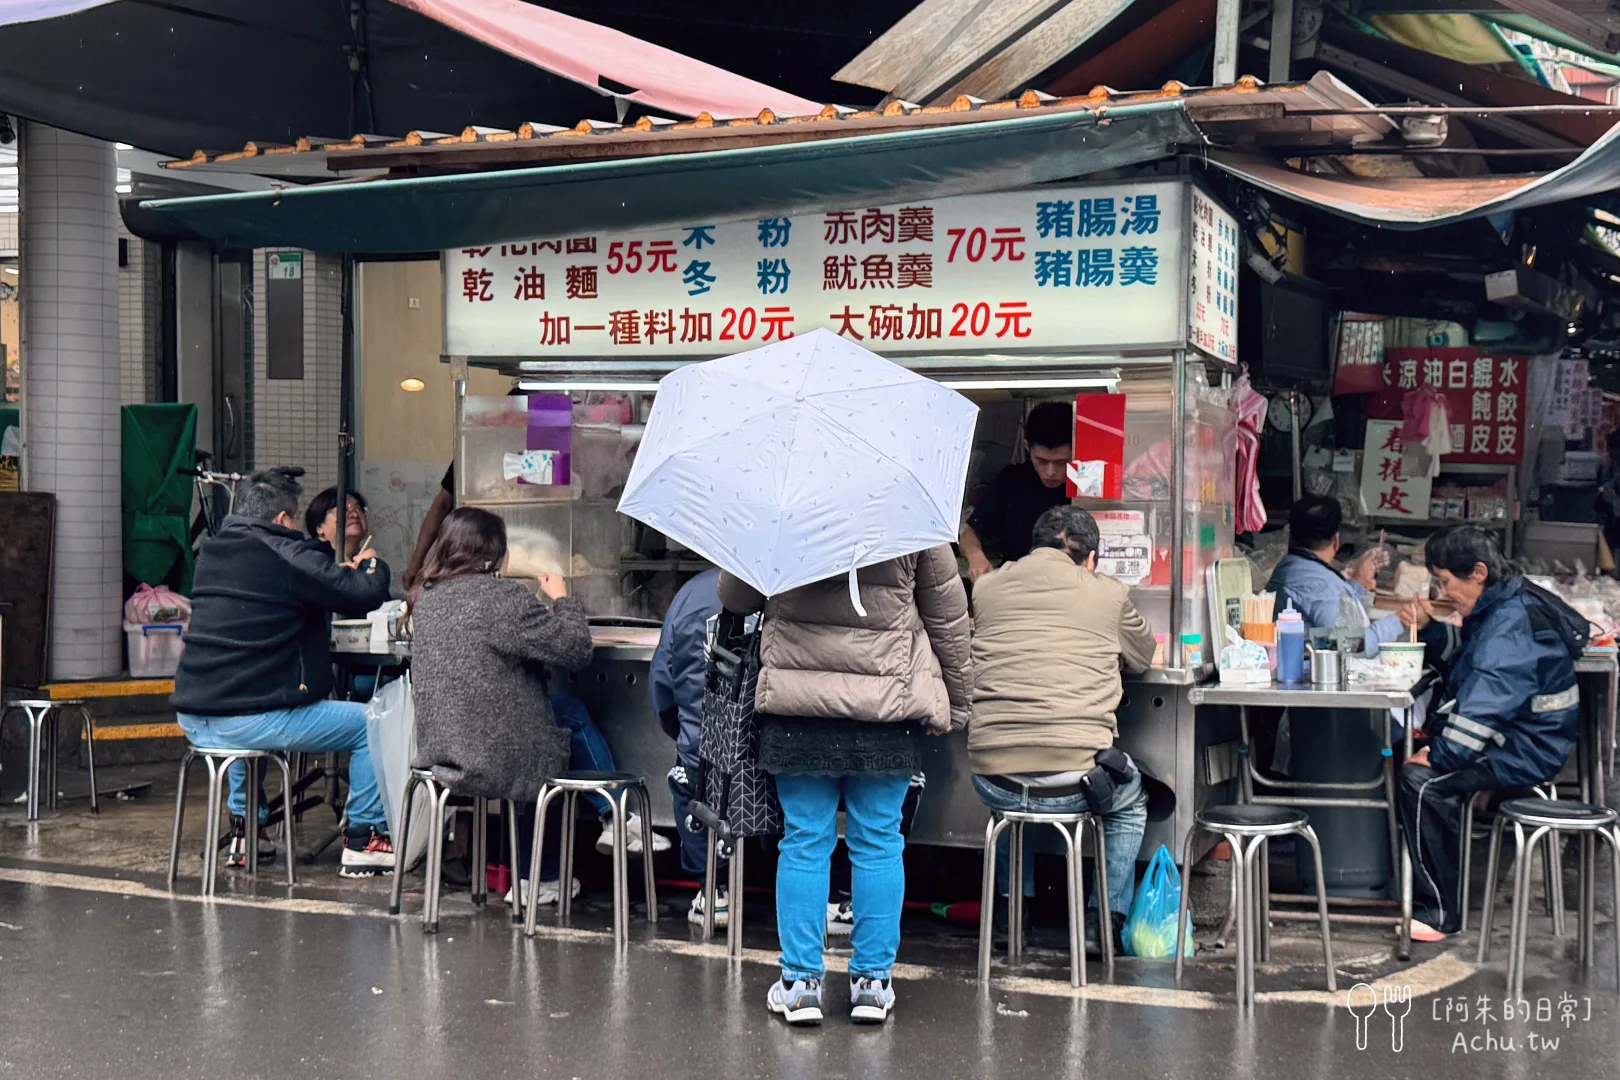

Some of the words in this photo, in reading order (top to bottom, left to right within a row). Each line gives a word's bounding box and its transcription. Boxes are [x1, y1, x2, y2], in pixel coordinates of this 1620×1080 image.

[824, 206, 934, 245] 赤肉羹
[1036, 194, 1161, 239] 豬腸湯
[606, 240, 678, 275] 55元
[946, 227, 1026, 264] 70元
[462, 265, 599, 302] 乾油麵
[682, 258, 792, 297] 冬粉
[823, 252, 934, 291] 魷魚羹
[1034, 245, 1158, 288] 豬腸羹
[539, 306, 796, 346] 加一種料加20元
[829, 301, 1032, 342] 大碗加20元
[1470, 358, 1493, 454] 餛飩皮
[1496, 358, 1519, 454] 水餃皮
